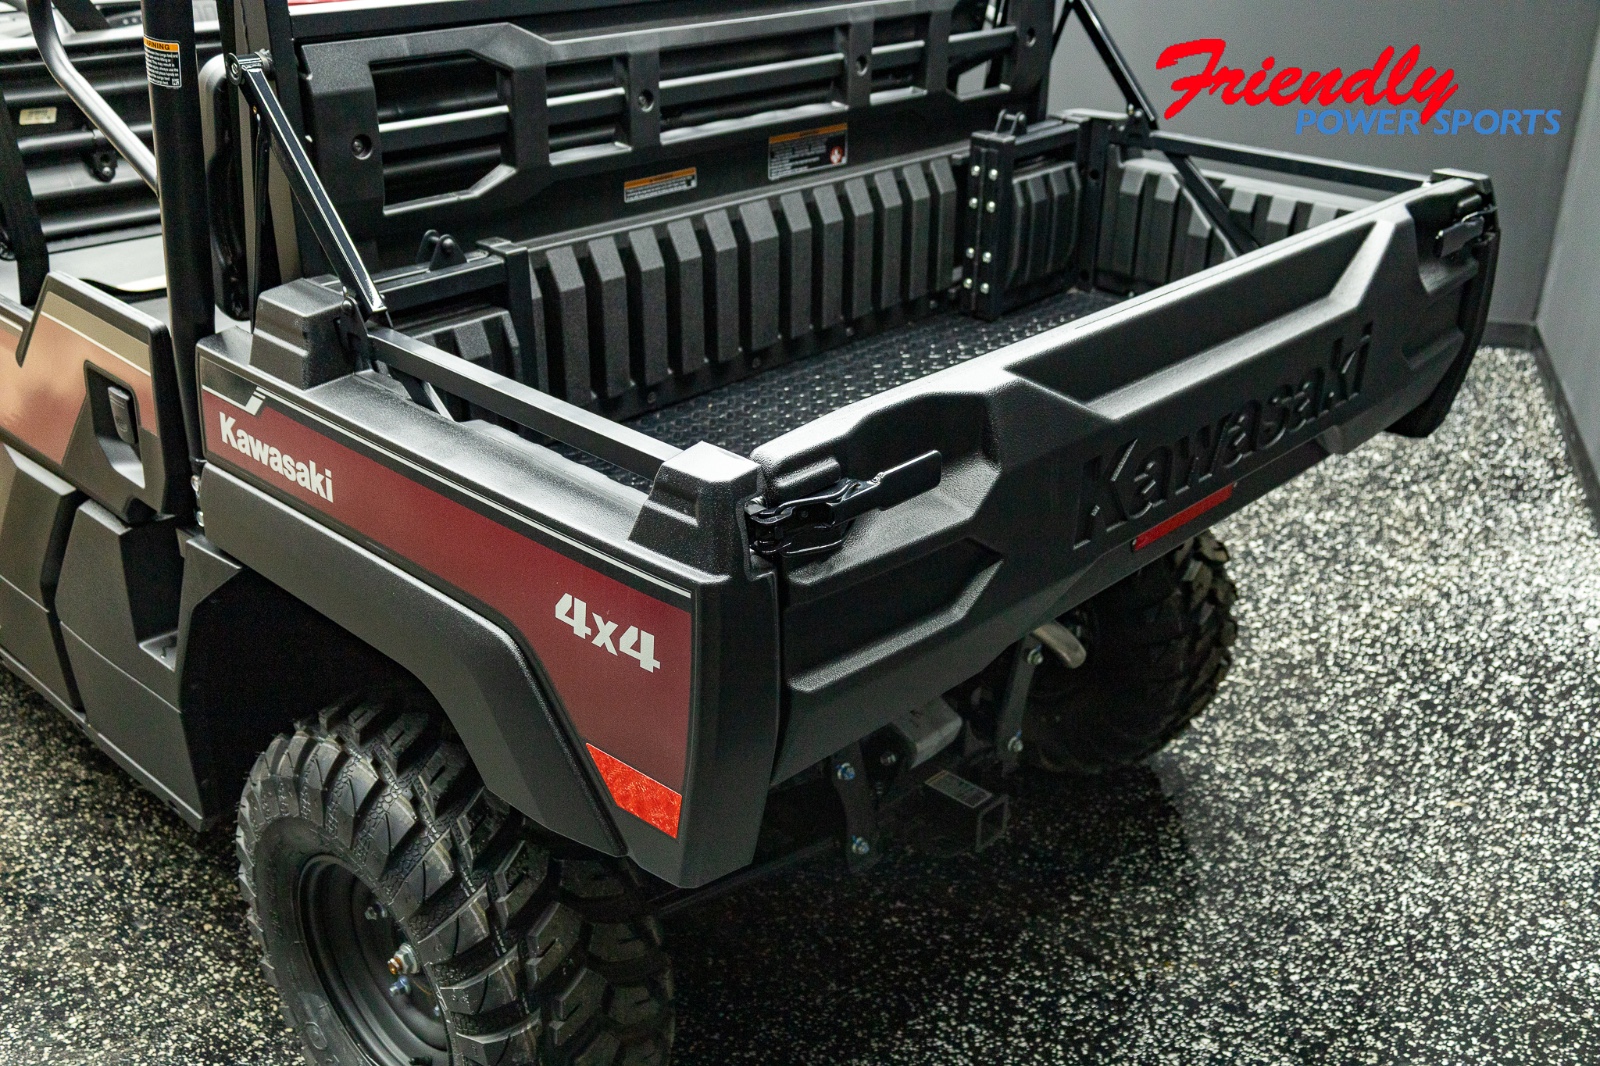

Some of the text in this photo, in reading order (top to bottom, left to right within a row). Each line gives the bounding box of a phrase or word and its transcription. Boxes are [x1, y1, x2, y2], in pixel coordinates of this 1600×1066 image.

[219, 411, 334, 504] Kawasaki
[1073, 320, 1374, 550] Kawasaki
[555, 593, 661, 673] 4x4
